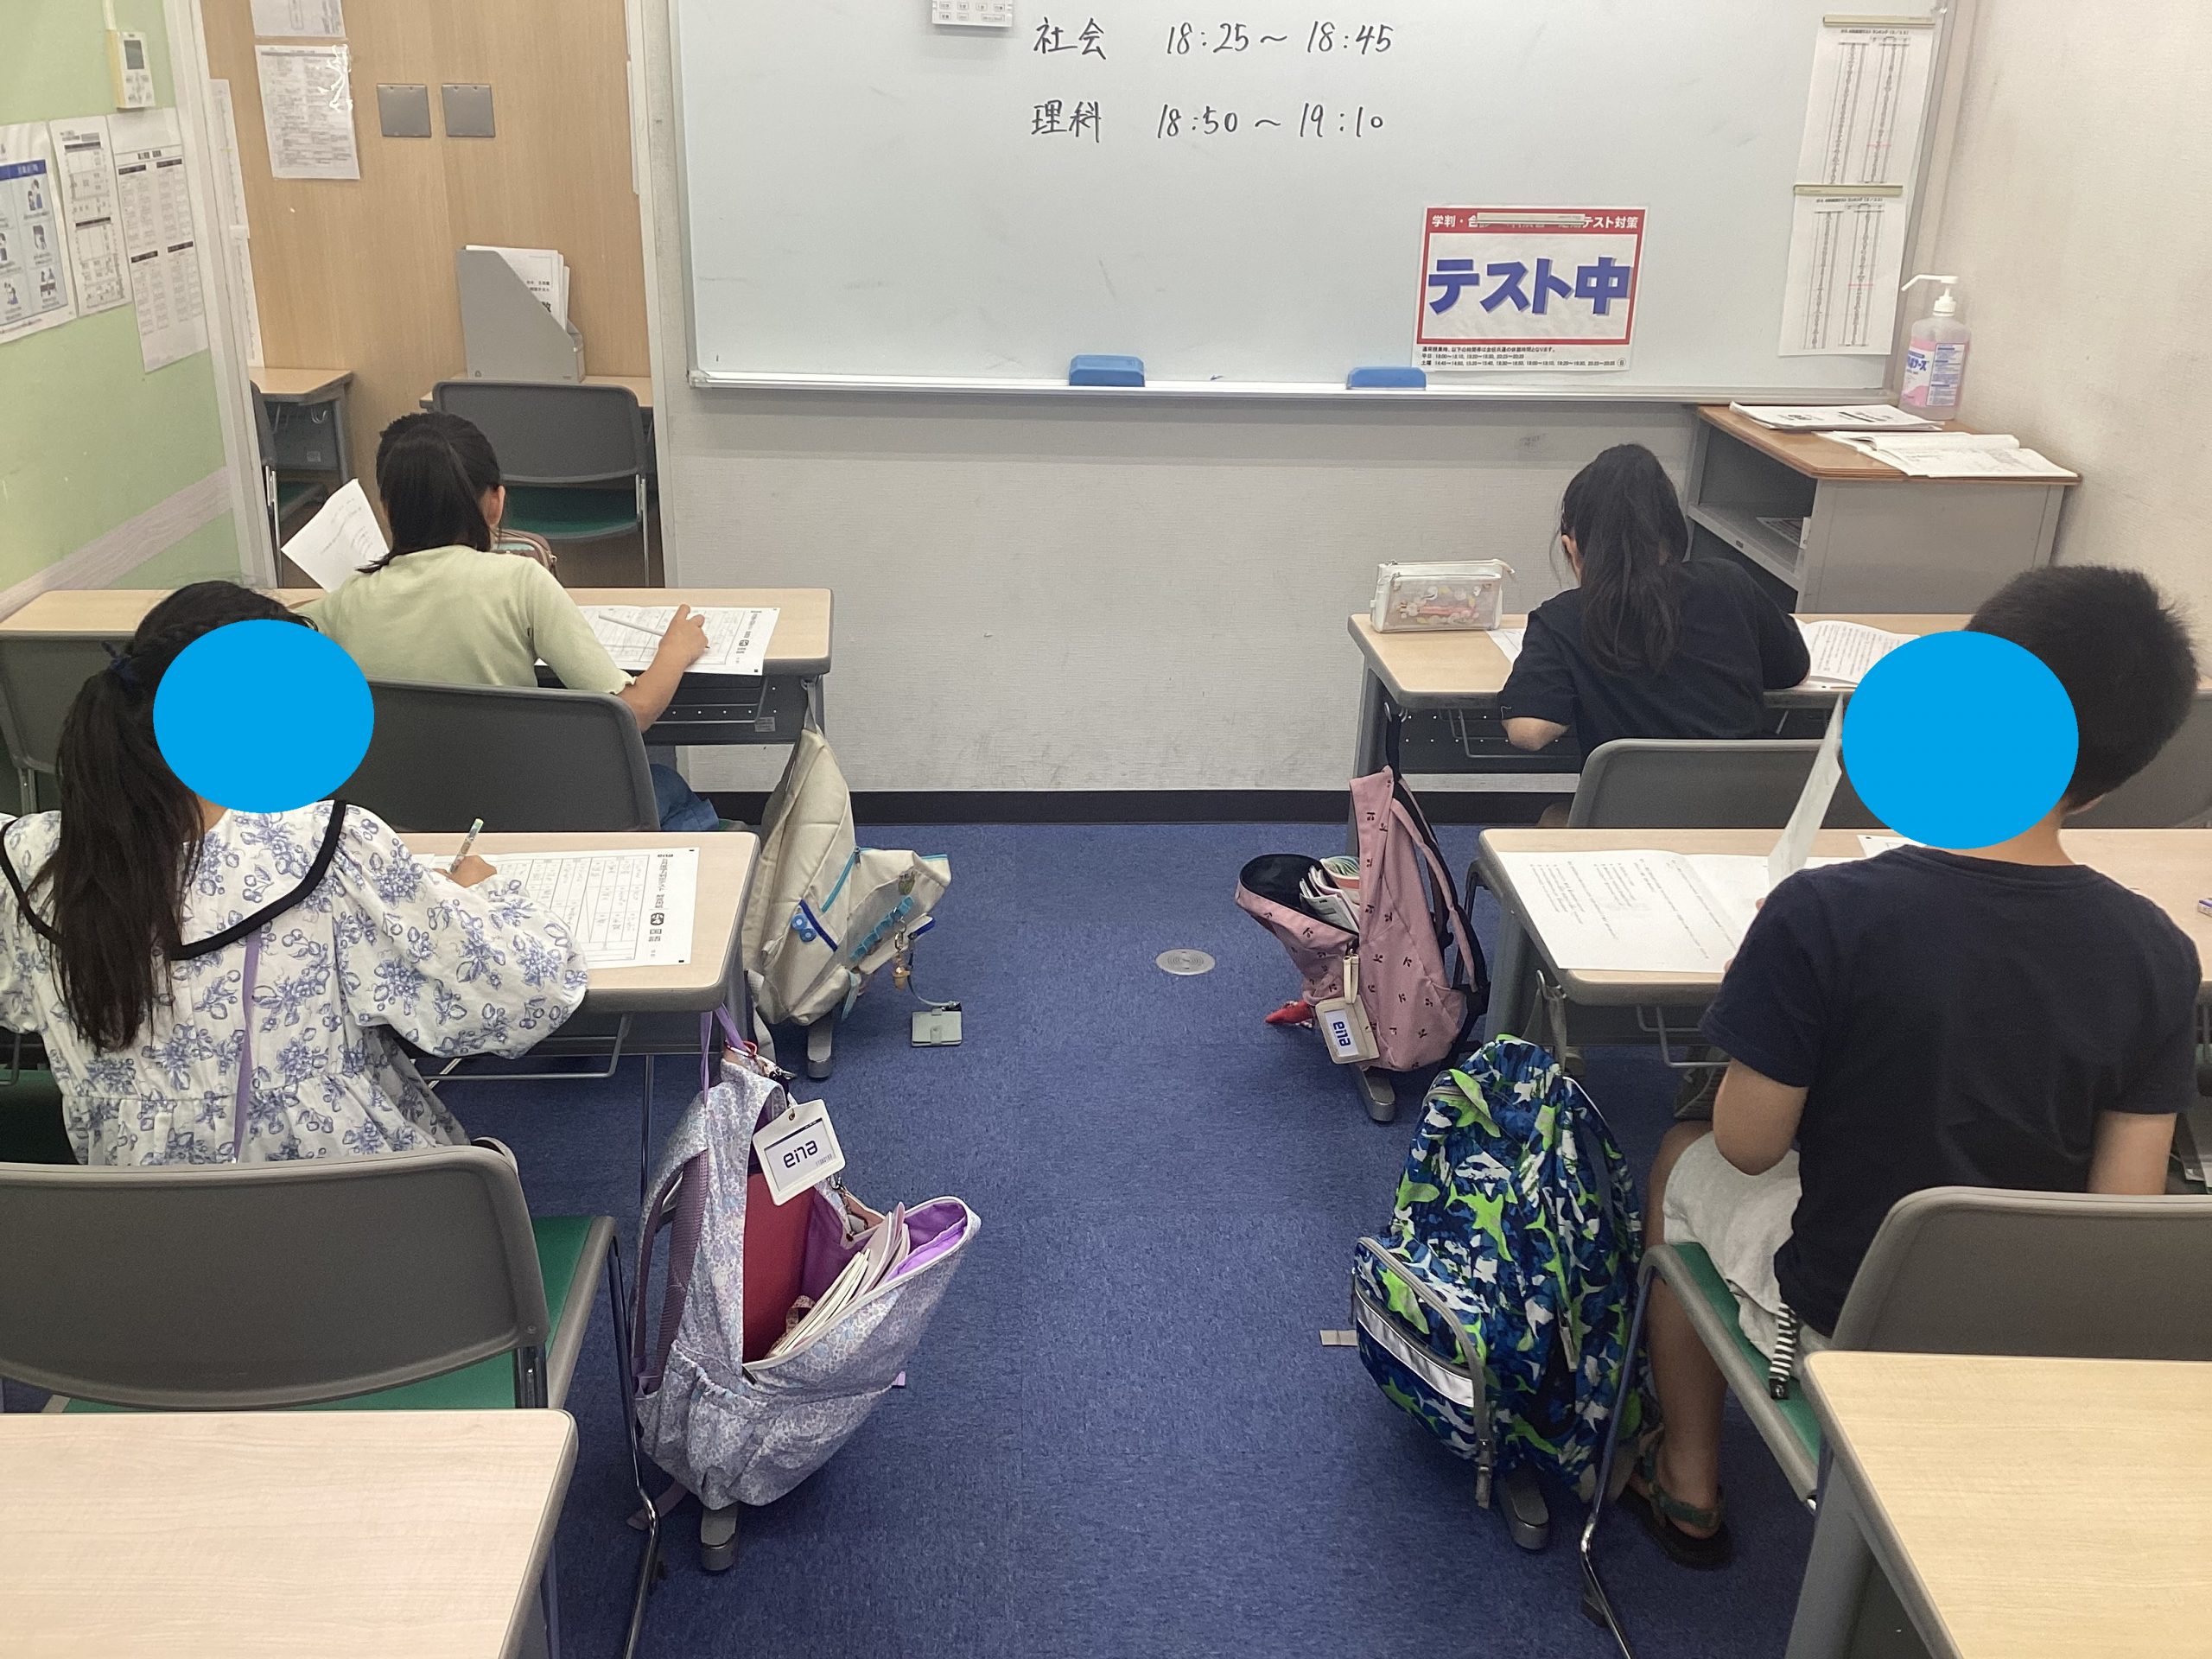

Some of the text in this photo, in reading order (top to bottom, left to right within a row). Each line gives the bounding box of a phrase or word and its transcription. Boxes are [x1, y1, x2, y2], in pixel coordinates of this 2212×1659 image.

[1033, 16, 1107, 60] 社会
[1031, 99, 1102, 143] 理科
[1428, 257, 1631, 315] テスト中
[1332, 1021, 1351, 1047] ena
[783, 1140, 818, 1168] ena
